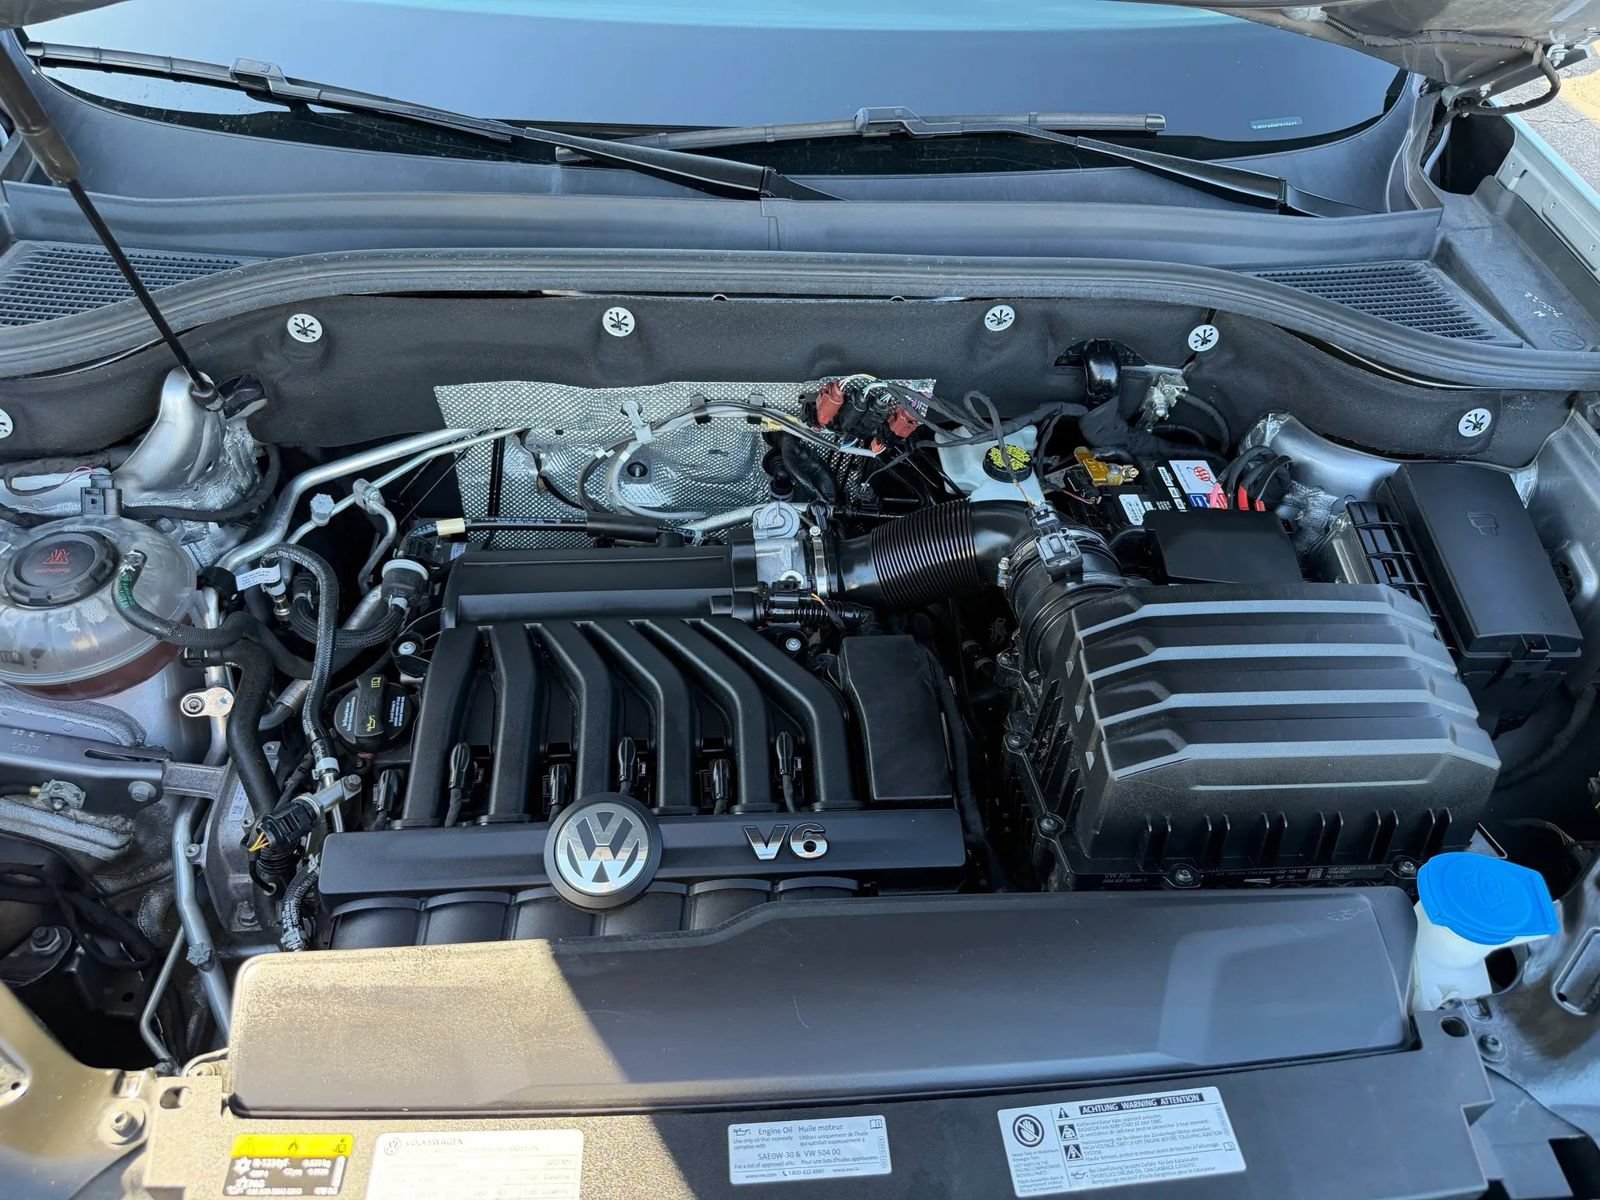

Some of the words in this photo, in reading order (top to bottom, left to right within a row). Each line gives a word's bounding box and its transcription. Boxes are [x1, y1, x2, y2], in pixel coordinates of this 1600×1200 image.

[744, 824, 828, 860] V6
[1081, 1103, 1119, 1114] ACHTUNG
[1121, 1099, 1158, 1109] WARNING
[1159, 1094, 1200, 1105] ATTENTION
[758, 1127, 782, 1137] Engine
[818, 1123, 843, 1131] moteur
